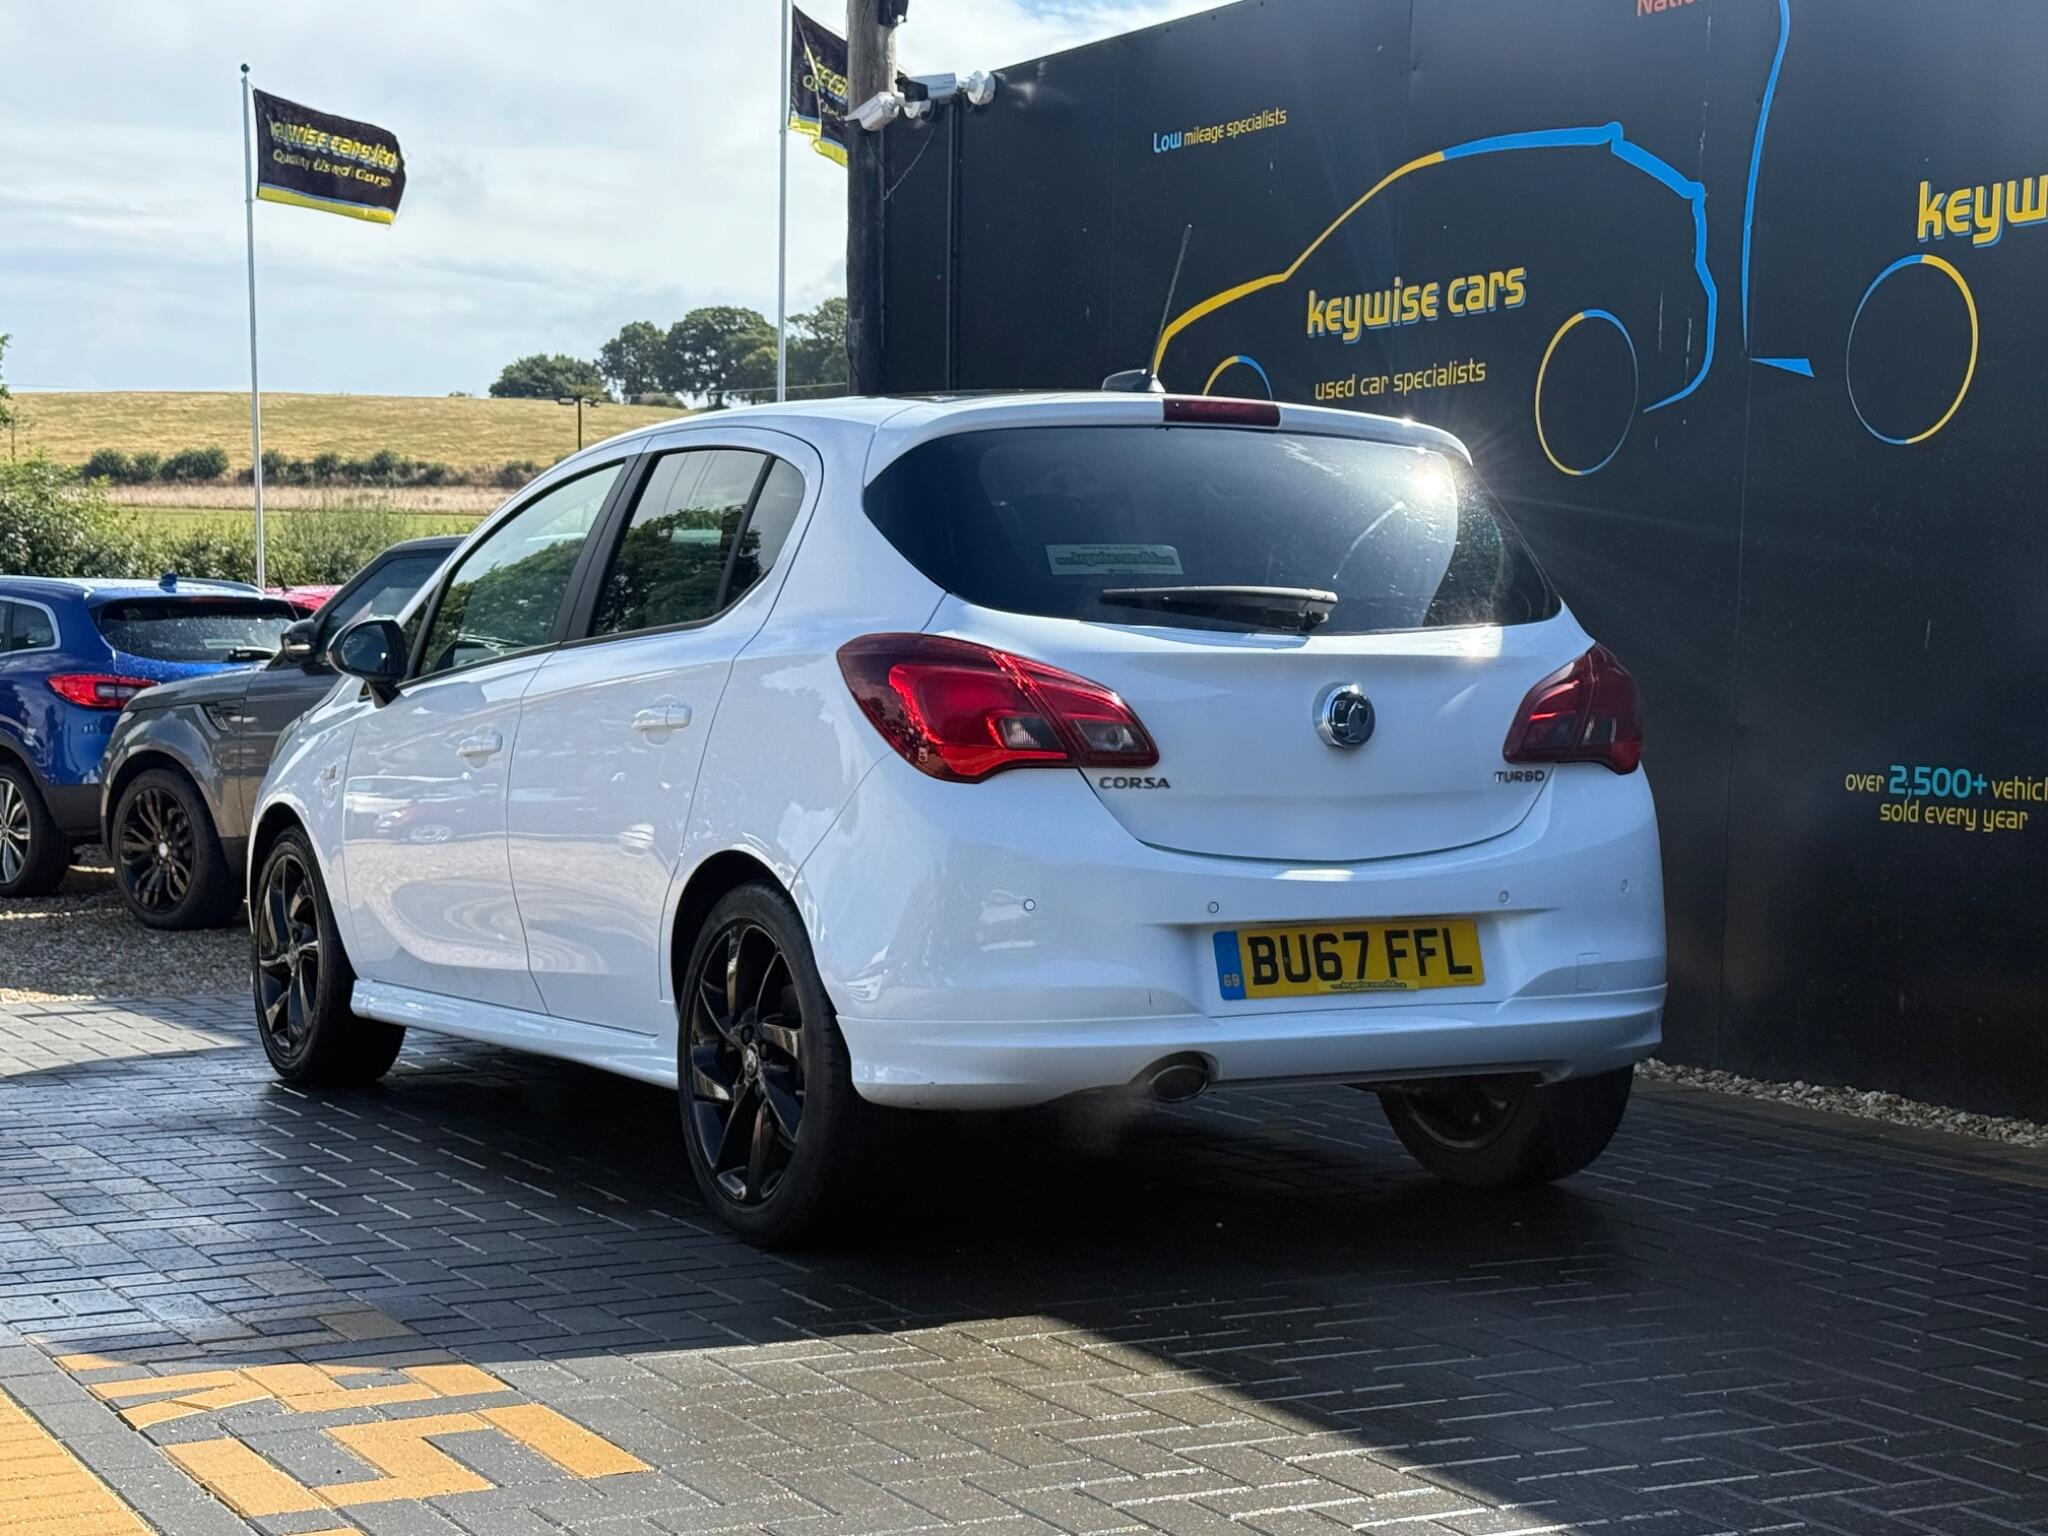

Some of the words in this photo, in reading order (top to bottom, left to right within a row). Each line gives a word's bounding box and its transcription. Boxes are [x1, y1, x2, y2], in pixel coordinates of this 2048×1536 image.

[1153, 131, 1182, 153] Low
[1184, 124, 1224, 146] mileage
[1226, 107, 1287, 138] specialists
[1307, 276, 1440, 344] keywise
[1447, 267, 1527, 317] cars
[1314, 373, 1356, 401] used
[1360, 376, 1389, 396] car
[1393, 358, 1486, 396] specialists
[1099, 776, 1171, 789] CORSA
[1494, 769, 1545, 783] TURBO
[1845, 774, 1885, 793] over
[1889, 765, 1988, 800] 2,500+
[1880, 800, 1920, 823] sold
[1924, 806, 1977, 831] every
[1983, 808, 2028, 832] year
[1248, 930, 1369, 986] BU67
[1384, 928, 1473, 978] FFL
[1223, 974, 1241, 988] GB
